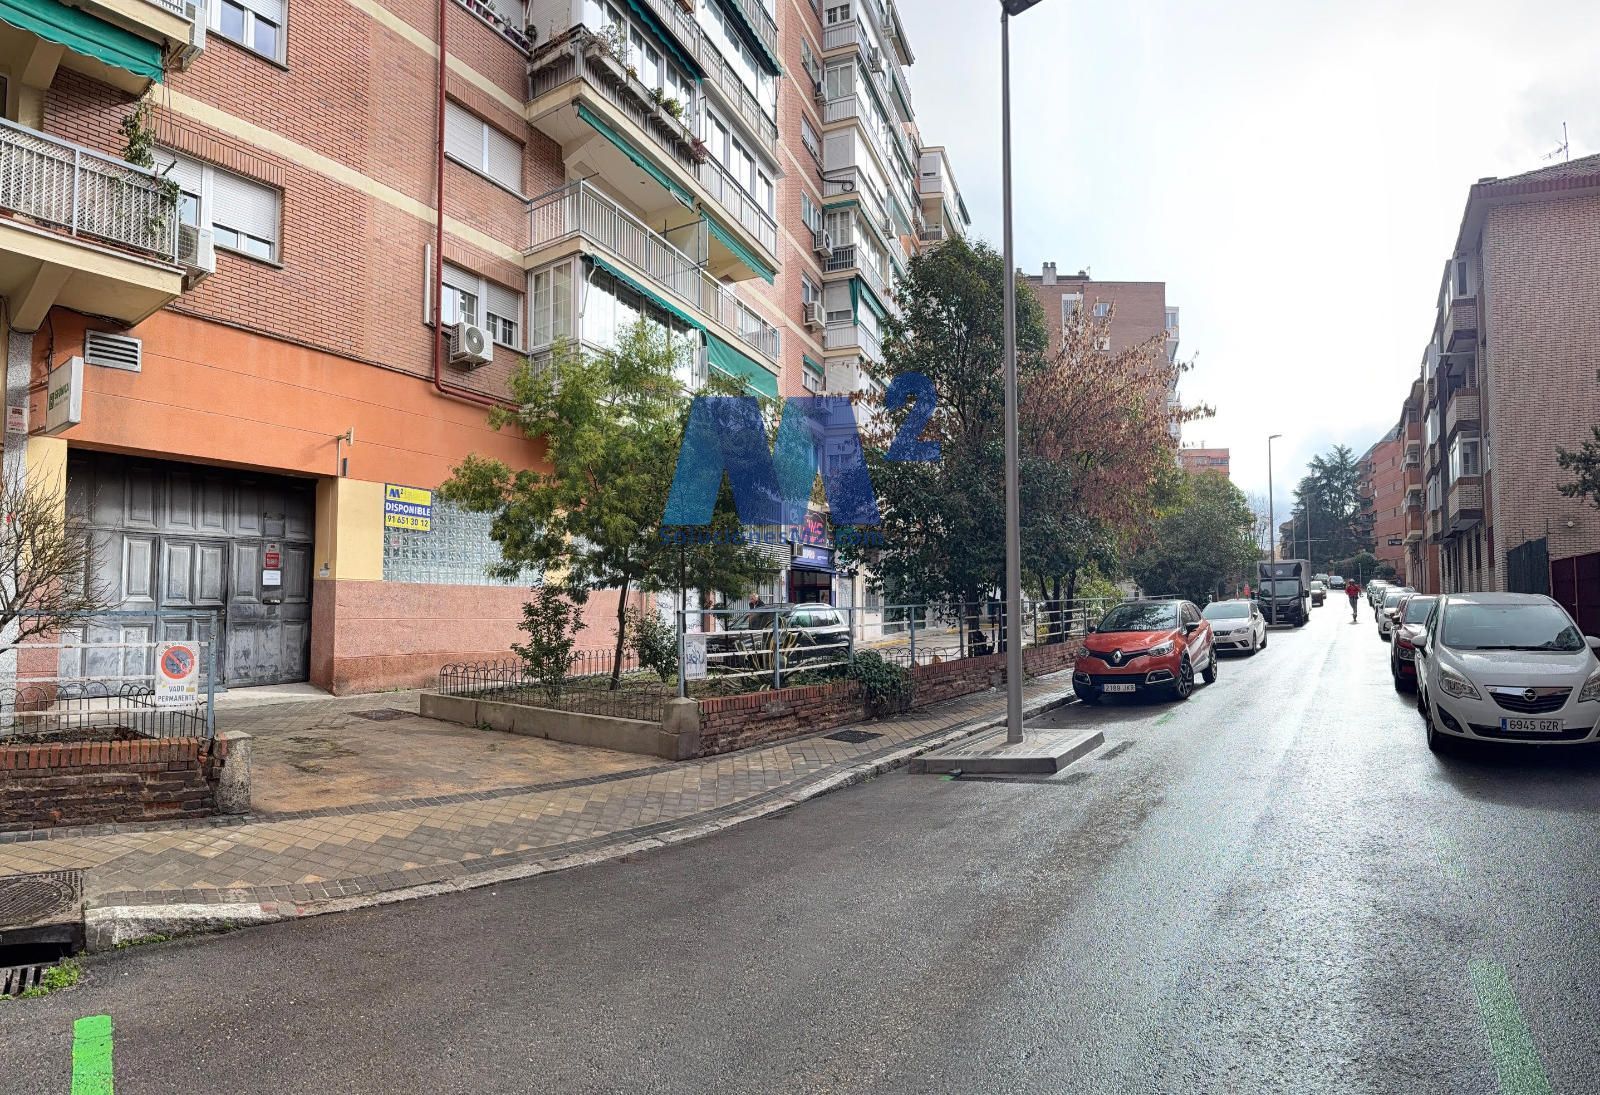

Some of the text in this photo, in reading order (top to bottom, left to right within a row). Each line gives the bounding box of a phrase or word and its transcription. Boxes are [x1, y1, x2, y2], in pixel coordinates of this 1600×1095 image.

[385, 502, 431, 517] DISPONIBLE
[387, 514, 429, 528] 91 651 30 12
[169, 685, 185, 693] VADO
[157, 694, 196, 703] PERMANENTE
[1509, 720, 1559, 731] 6945 GZR
